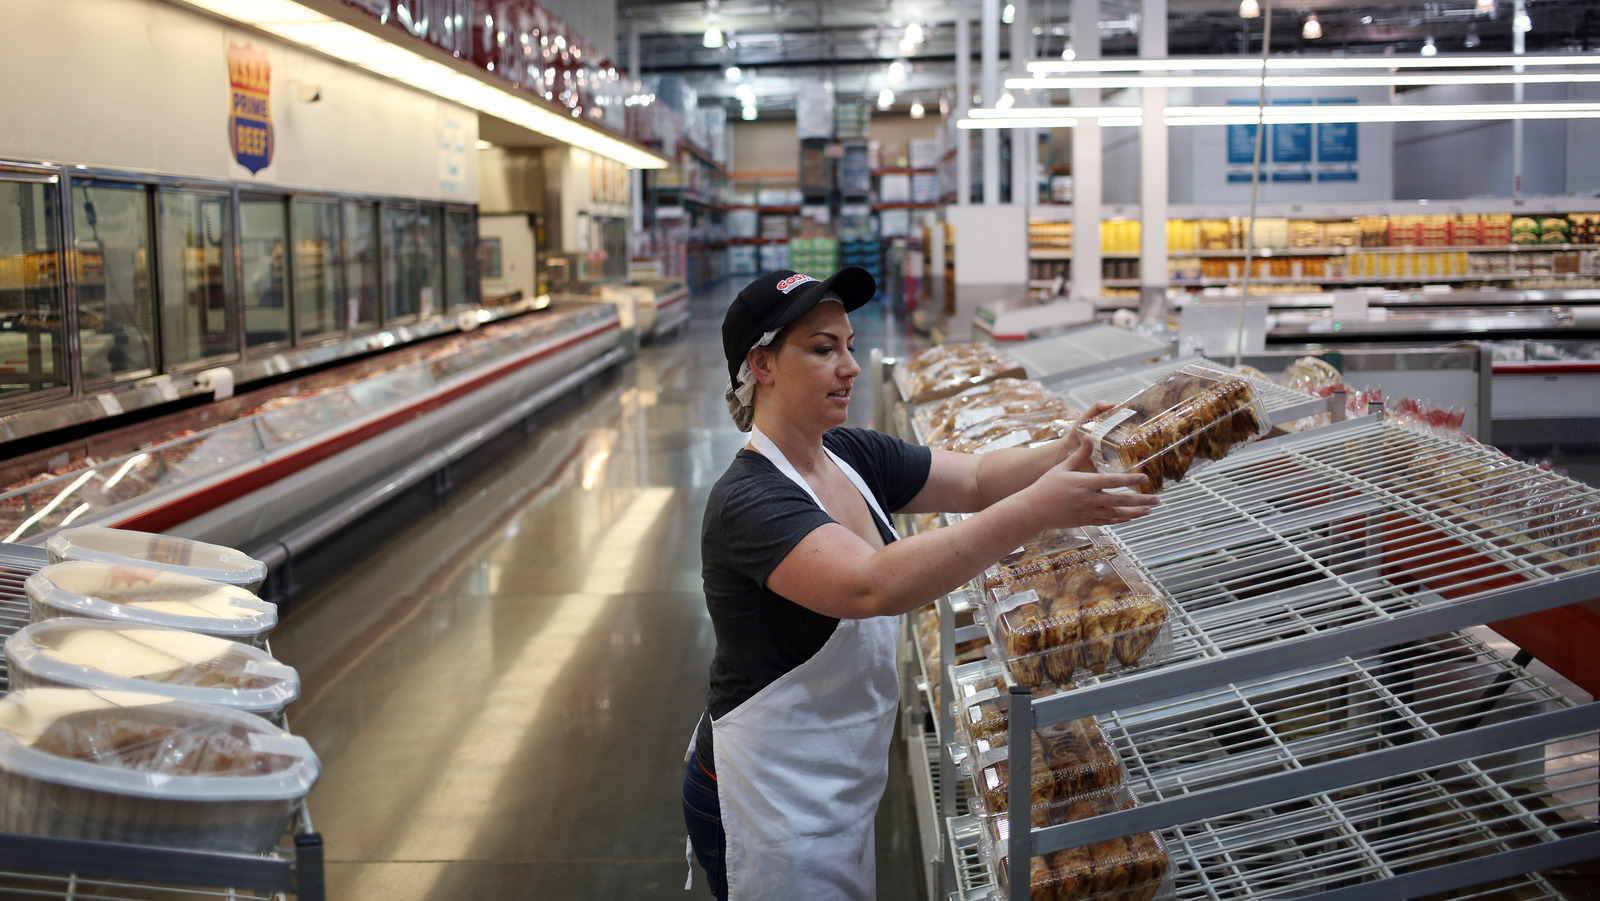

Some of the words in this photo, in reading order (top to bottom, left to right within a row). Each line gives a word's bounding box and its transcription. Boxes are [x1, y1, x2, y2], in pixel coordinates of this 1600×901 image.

[233, 92, 267, 118] PRIME
[237, 124, 266, 156] BEEF
[777, 274, 809, 290] COST
